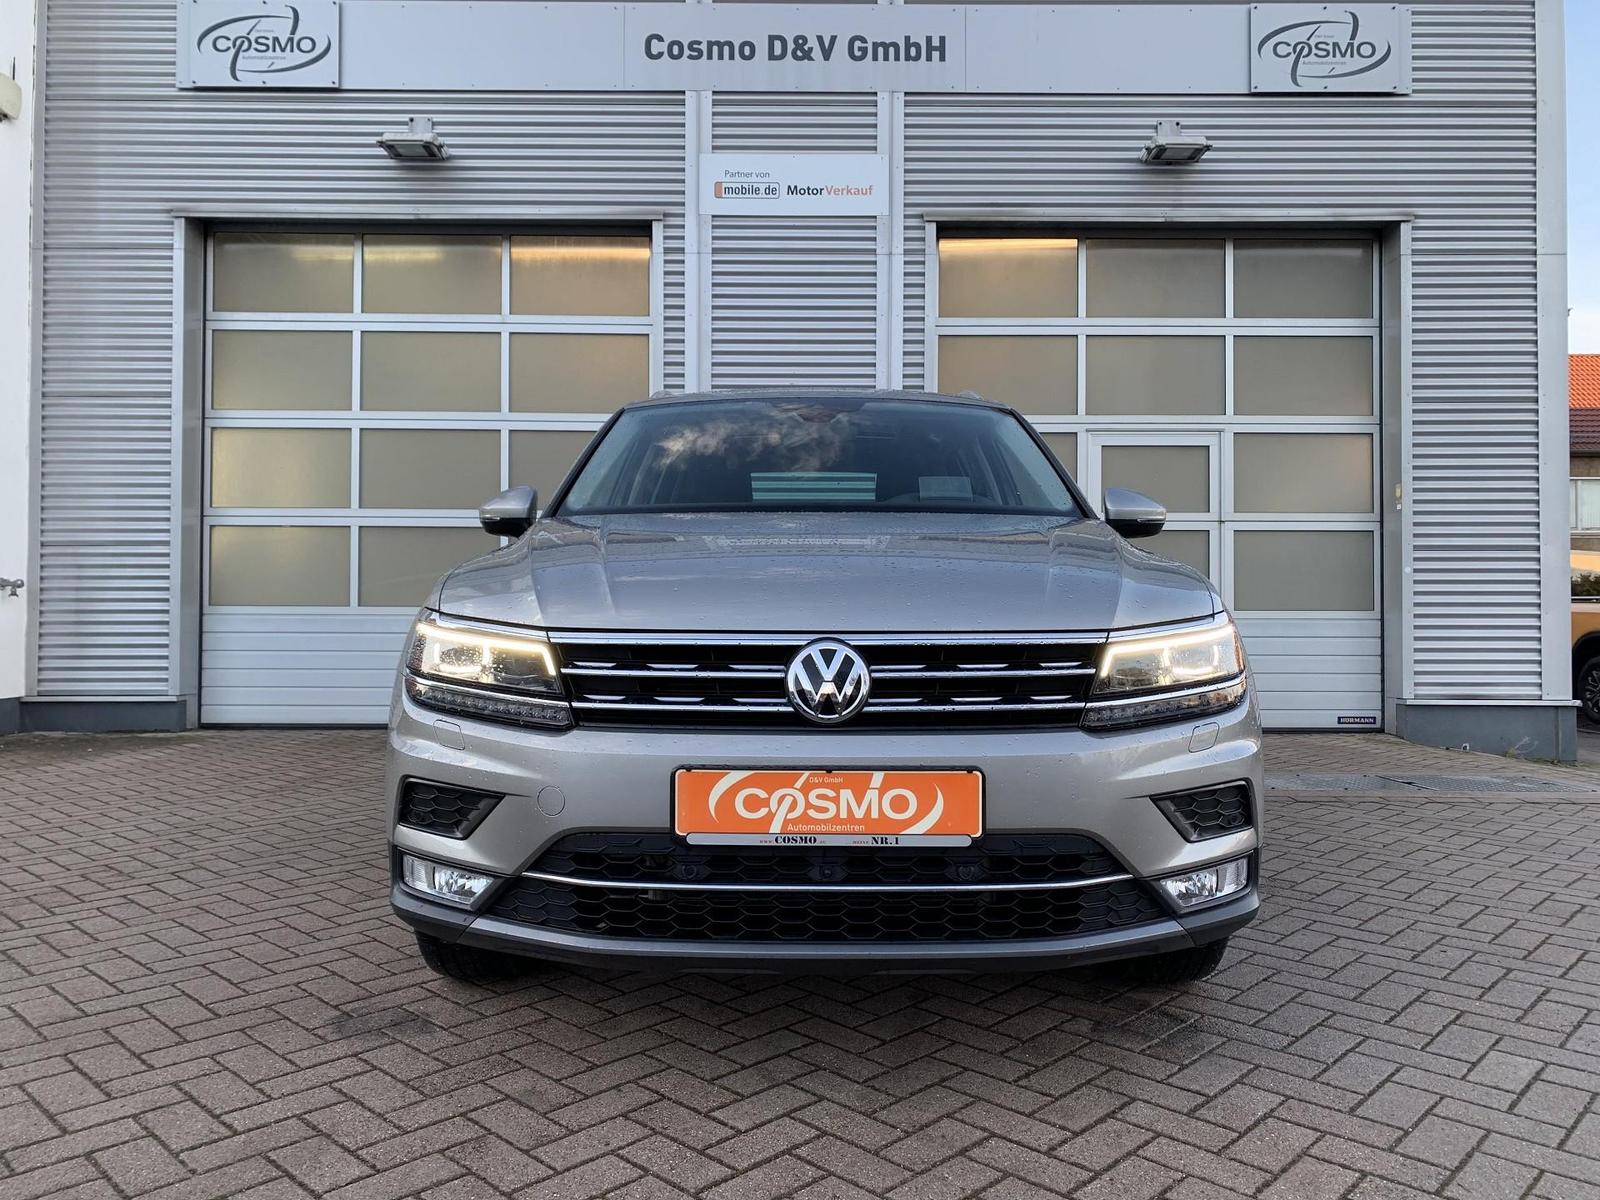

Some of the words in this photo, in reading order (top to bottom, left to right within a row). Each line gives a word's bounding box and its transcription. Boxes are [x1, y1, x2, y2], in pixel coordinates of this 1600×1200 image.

[211, 35, 317, 53] COSMO
[644, 33, 756, 61] Cosmo
[767, 34, 838, 62] D&V
[847, 35, 946, 62] GmbH
[1272, 41, 1377, 59] COSMO
[724, 170, 754, 179] Partner
[755, 171, 770, 179] von
[723, 184, 778, 196] mobile.de
[734, 787, 918, 820] COSMO
[787, 823, 865, 832] Automobilzentren
